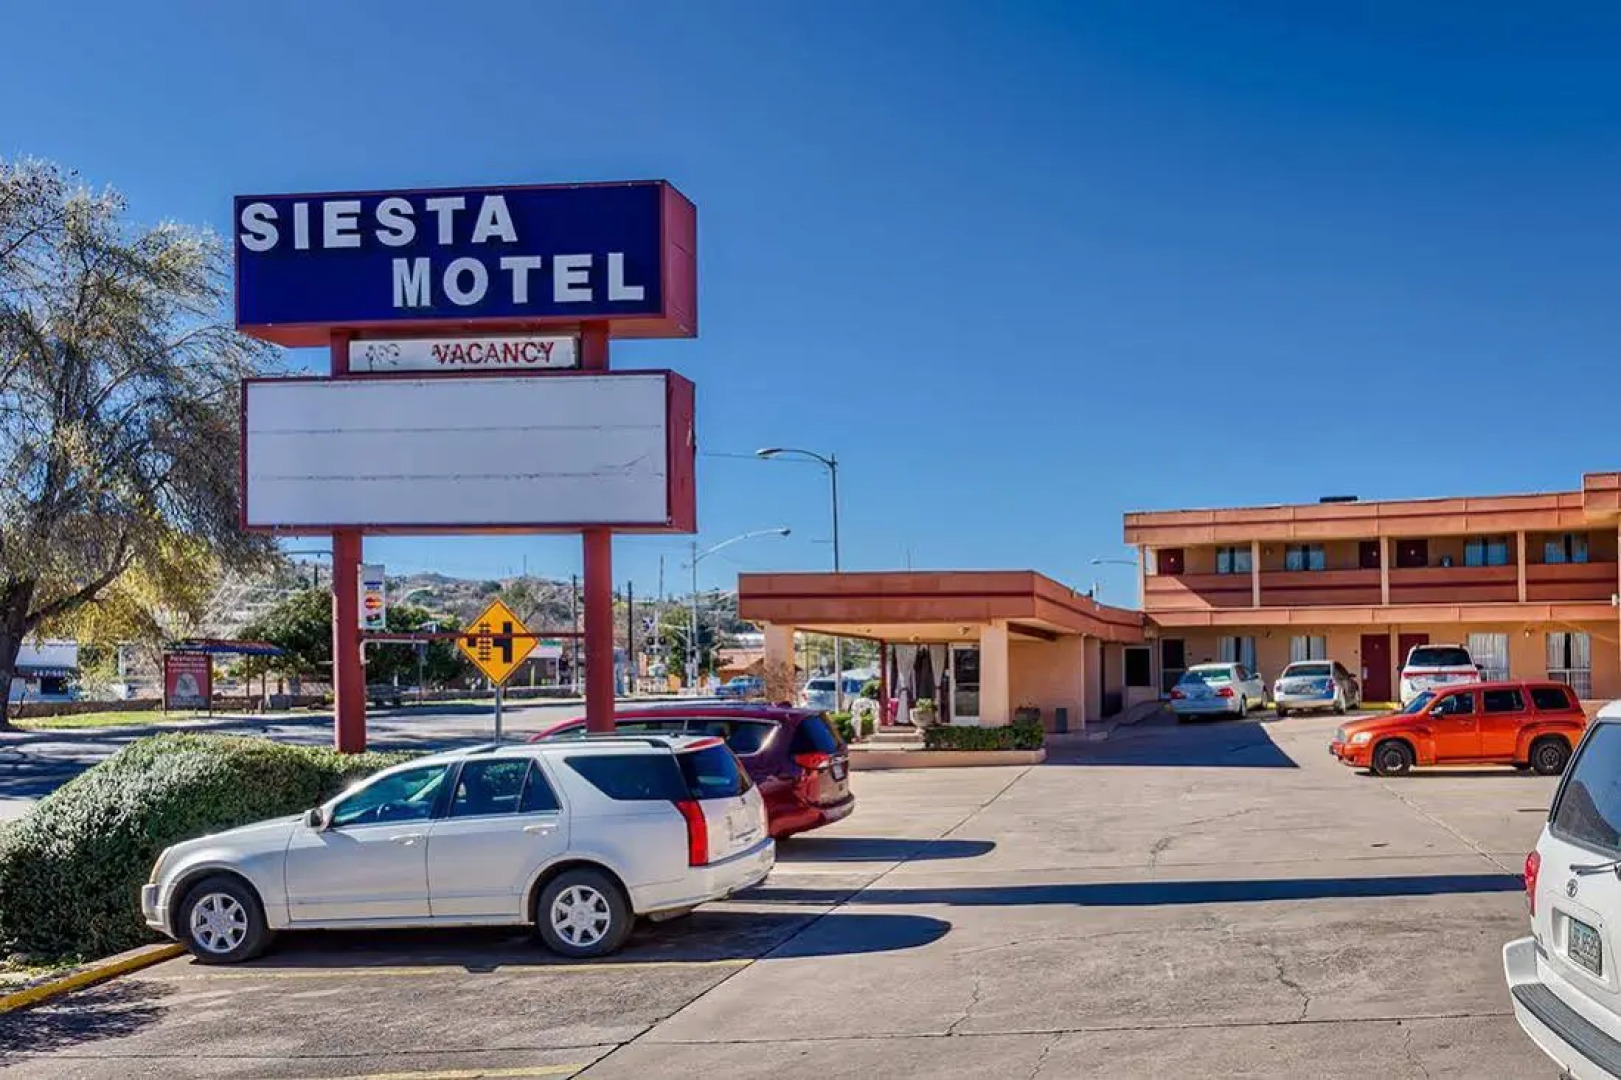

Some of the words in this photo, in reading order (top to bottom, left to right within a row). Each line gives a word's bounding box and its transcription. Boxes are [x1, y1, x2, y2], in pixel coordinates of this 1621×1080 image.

[240, 195, 518, 252] SIESTA
[393, 252, 645, 308] MOTEL
[432, 341, 554, 365] VACANCY
